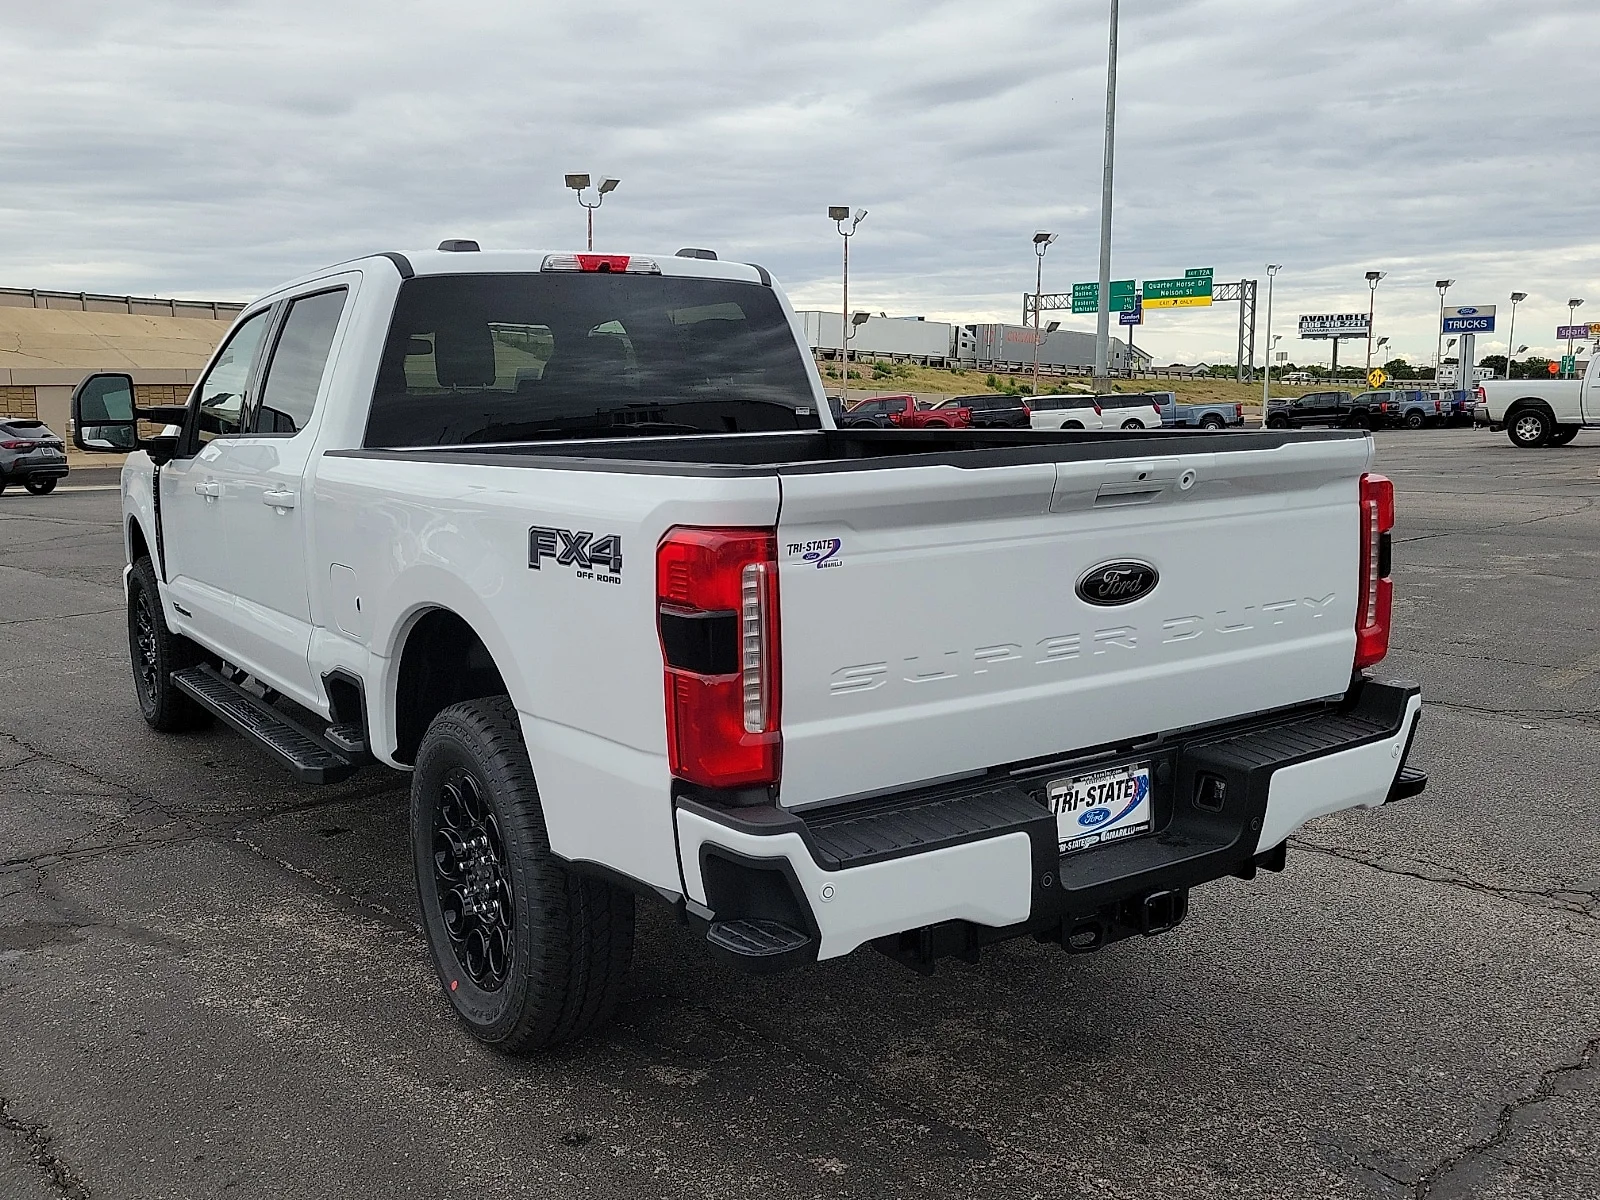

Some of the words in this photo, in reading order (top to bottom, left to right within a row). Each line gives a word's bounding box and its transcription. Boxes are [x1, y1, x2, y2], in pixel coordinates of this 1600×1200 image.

[1148, 282, 1174, 290] Quarter
[1176, 280, 1195, 288] Horse
[1160, 289, 1184, 297] Nelson
[1300, 313, 1368, 322] AVAILABLE
[1447, 319, 1488, 330] TRUCKS
[528, 525, 623, 574] FX4
[786, 539, 833, 556] TRI-STATE
[576, 570, 594, 580] OFF
[596, 573, 622, 585] ROAD
[830, 624, 1138, 696] SUPER
[1162, 592, 1336, 645] DUTY
[1051, 777, 1135, 815] TRI-STATE
